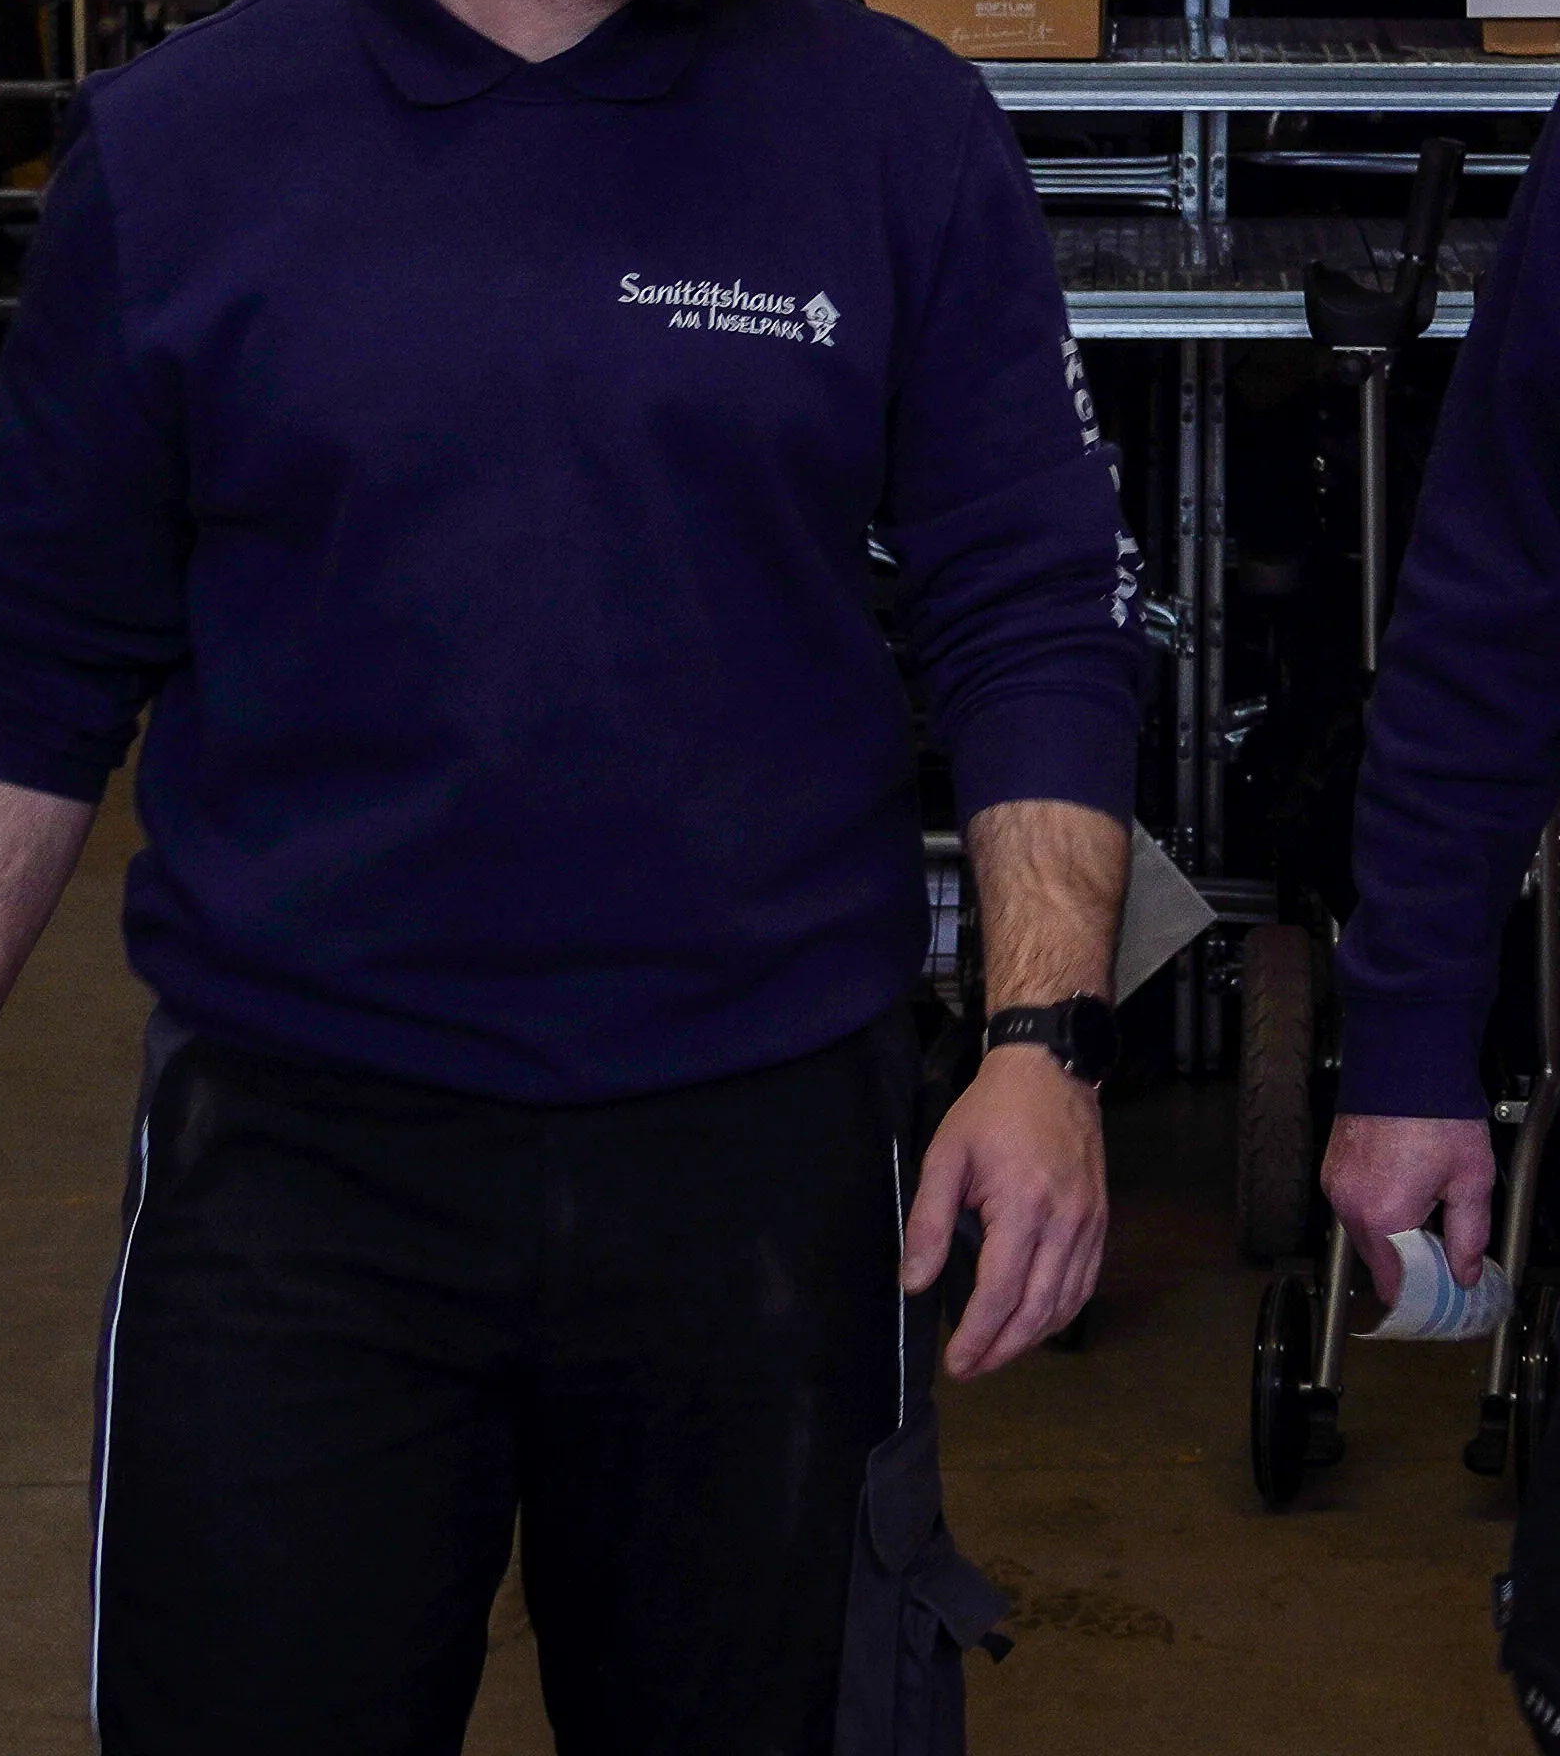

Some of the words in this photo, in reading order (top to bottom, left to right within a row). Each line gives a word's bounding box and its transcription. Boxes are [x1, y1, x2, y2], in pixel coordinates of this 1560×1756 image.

[618, 271, 795, 314] Sanitätshaus
[669, 308, 702, 330] AM
[707, 304, 804, 342] INSELPARK
